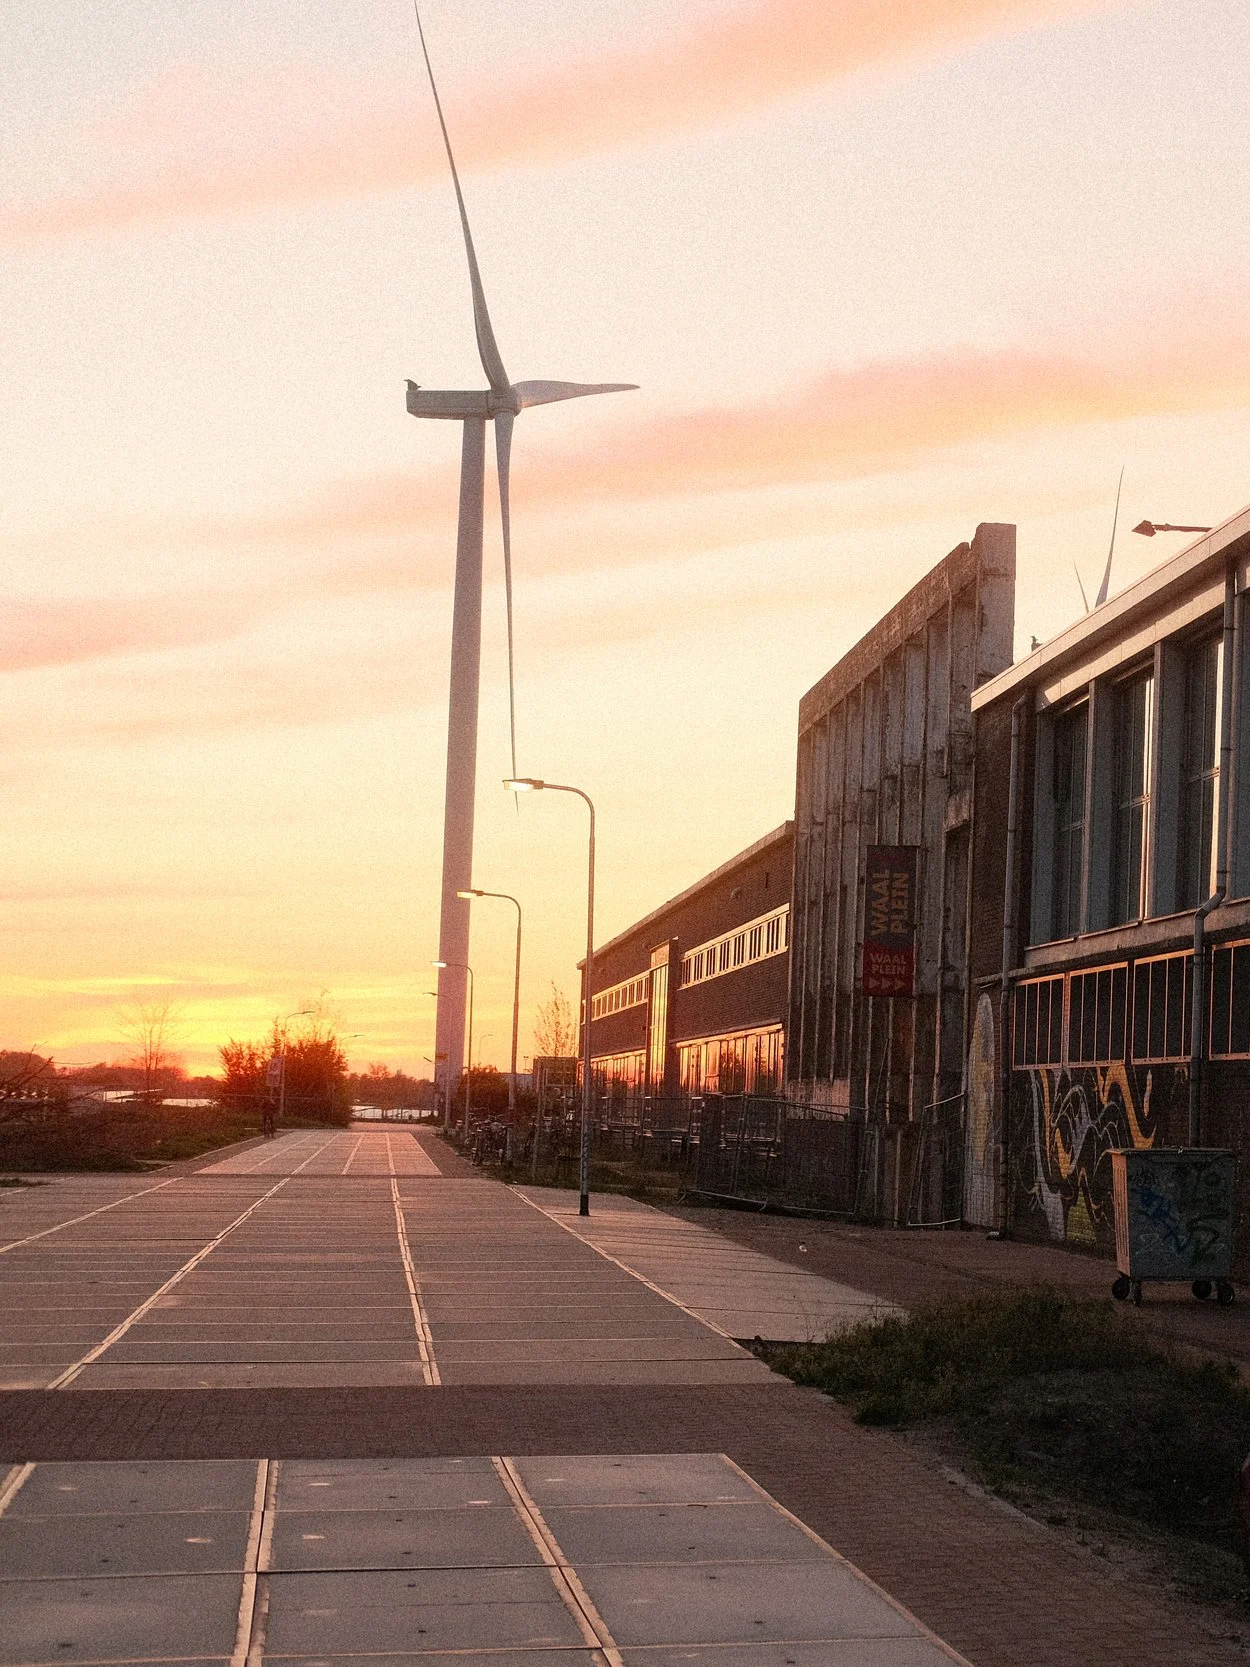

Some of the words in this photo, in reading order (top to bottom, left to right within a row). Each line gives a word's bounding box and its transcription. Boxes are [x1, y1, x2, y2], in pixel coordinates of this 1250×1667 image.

[871, 869, 891, 936] WAAL
[890, 872, 909, 934] PLEIN
[869, 952, 907, 965] WAAL
[871, 964, 906, 975] PLEIN
